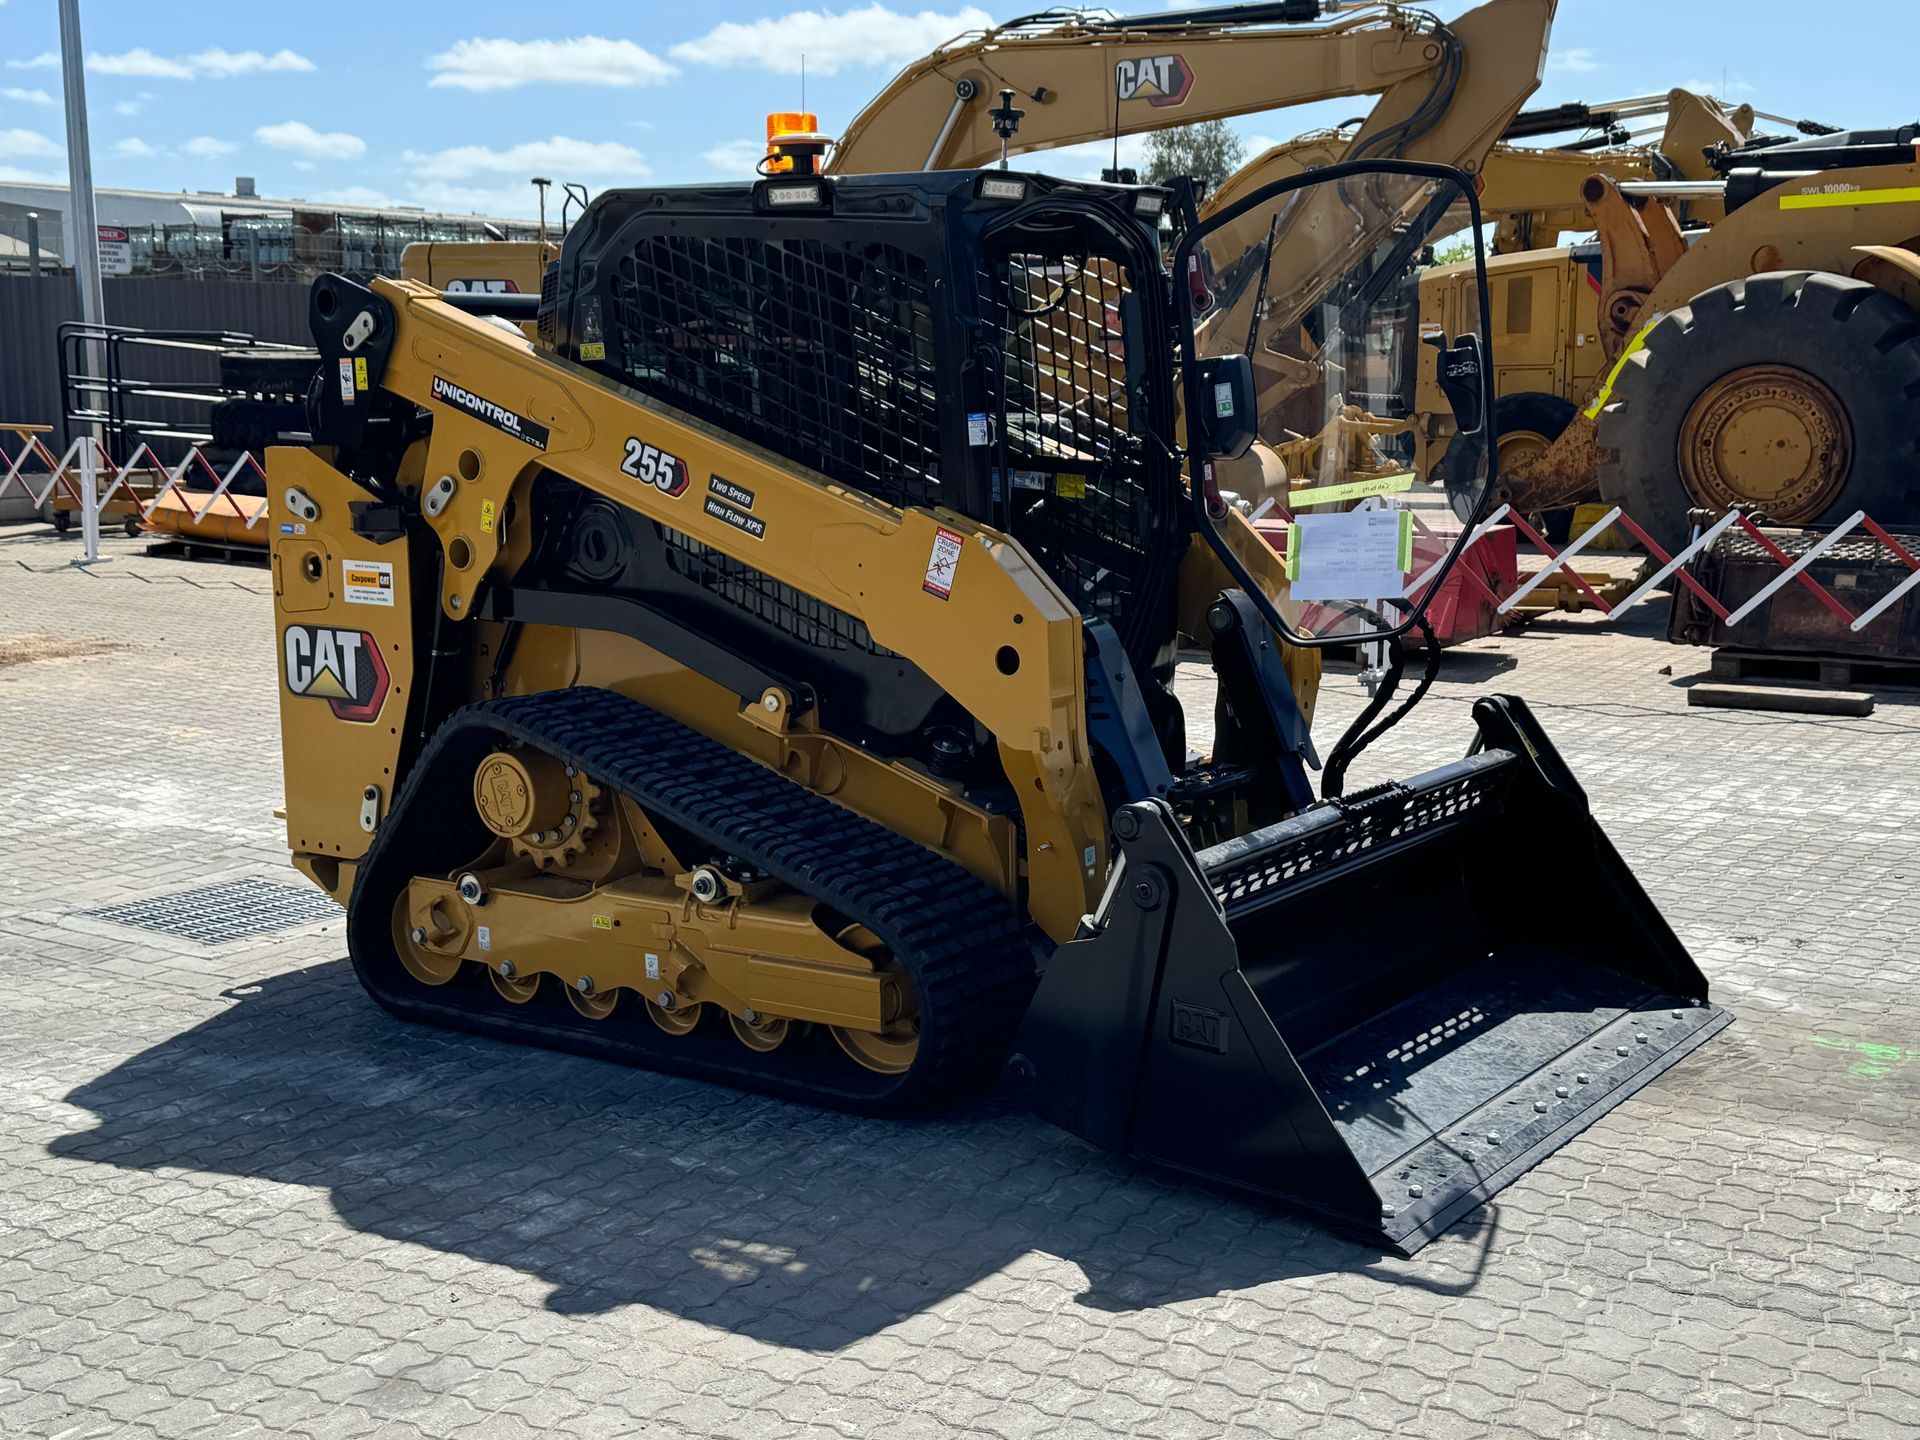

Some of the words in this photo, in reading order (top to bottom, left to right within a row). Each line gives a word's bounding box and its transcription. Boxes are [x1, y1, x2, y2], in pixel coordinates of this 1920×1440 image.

[1116, 56, 1174, 99] CAT
[1801, 186, 1822, 195] SWL
[433, 378, 522, 431] UNICONTROL
[621, 438, 676, 490] 255
[727, 487, 751, 504] SPEED
[707, 501, 725, 516] HIGH
[725, 509, 745, 526] FLOW
[745, 518, 763, 534] XPS
[937, 537, 959, 551] CRUSH
[937, 545, 955, 557] ZONE
[380, 575, 389, 585] CAT
[285, 625, 362, 700] CAT
[1175, 1009, 1220, 1045] CAT
